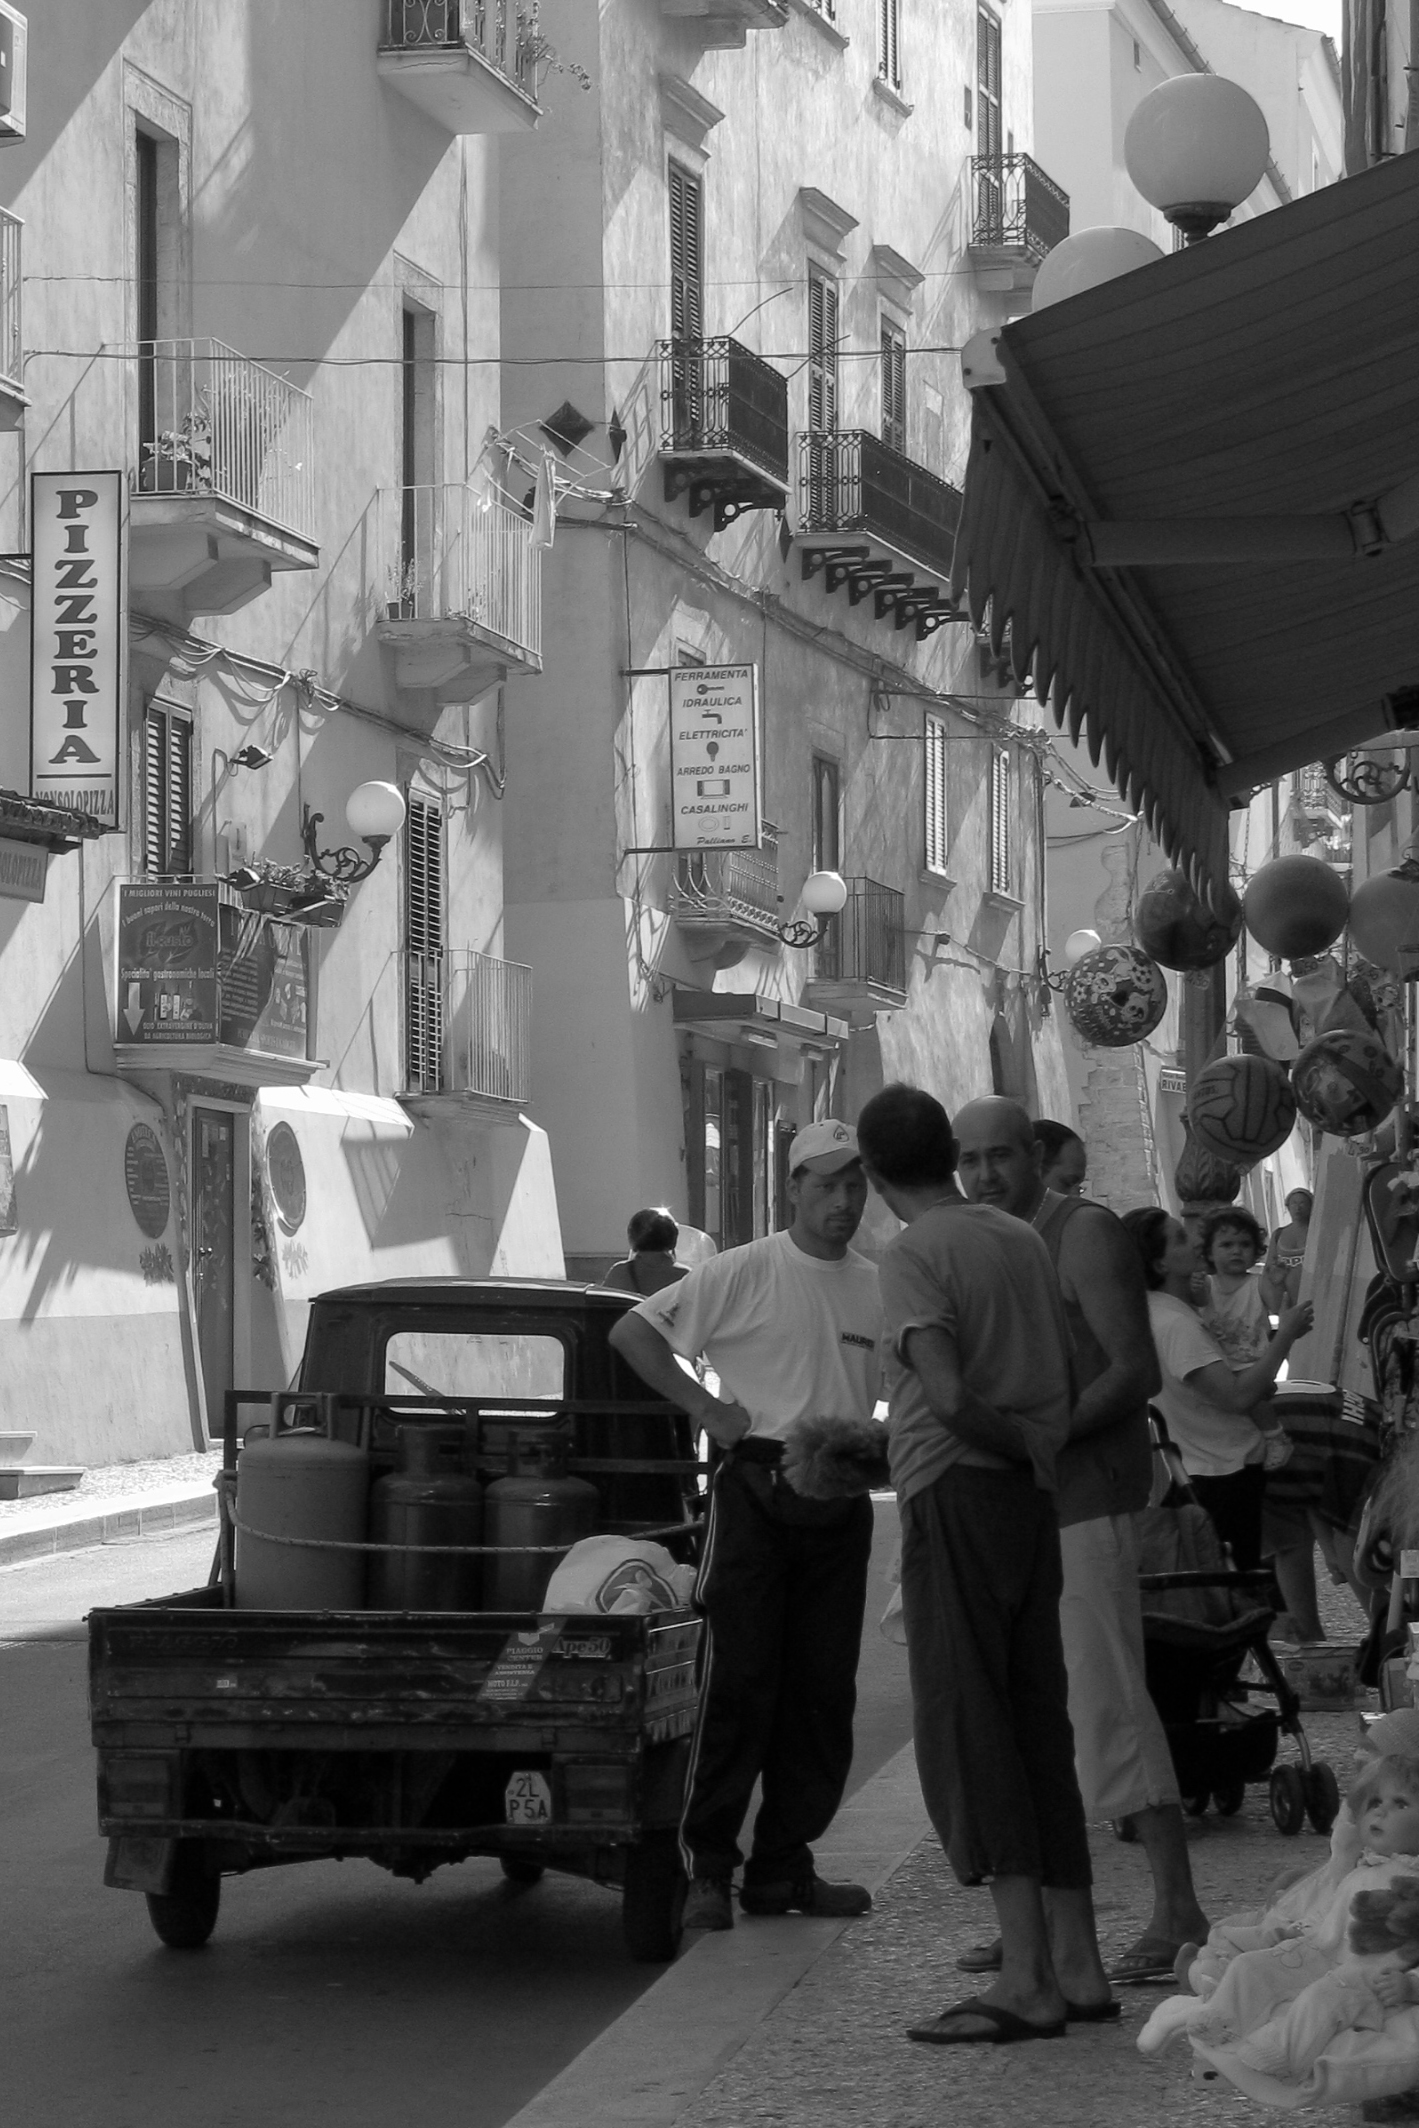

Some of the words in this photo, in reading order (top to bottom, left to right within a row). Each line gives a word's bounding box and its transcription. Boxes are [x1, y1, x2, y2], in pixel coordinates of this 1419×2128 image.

[48, 489, 101, 764] PIZZERIA
[674, 669, 748, 682] FERRAMENTA
[682, 696, 742, 708] IDRAULICA
[677, 765, 714, 776] ARREDO
[718, 764, 750, 774] BAGNO
[680, 802, 748, 815] CASALINGHI
[129, 889, 163, 898] MIGLIORI
[165, 889, 181, 898] VINI
[183, 888, 216, 898] PUGLIESI
[506, 1647, 544, 1655] PIAGGIO
[507, 1654, 543, 1662] CENTER
[515, 1777, 540, 1798] 2L
